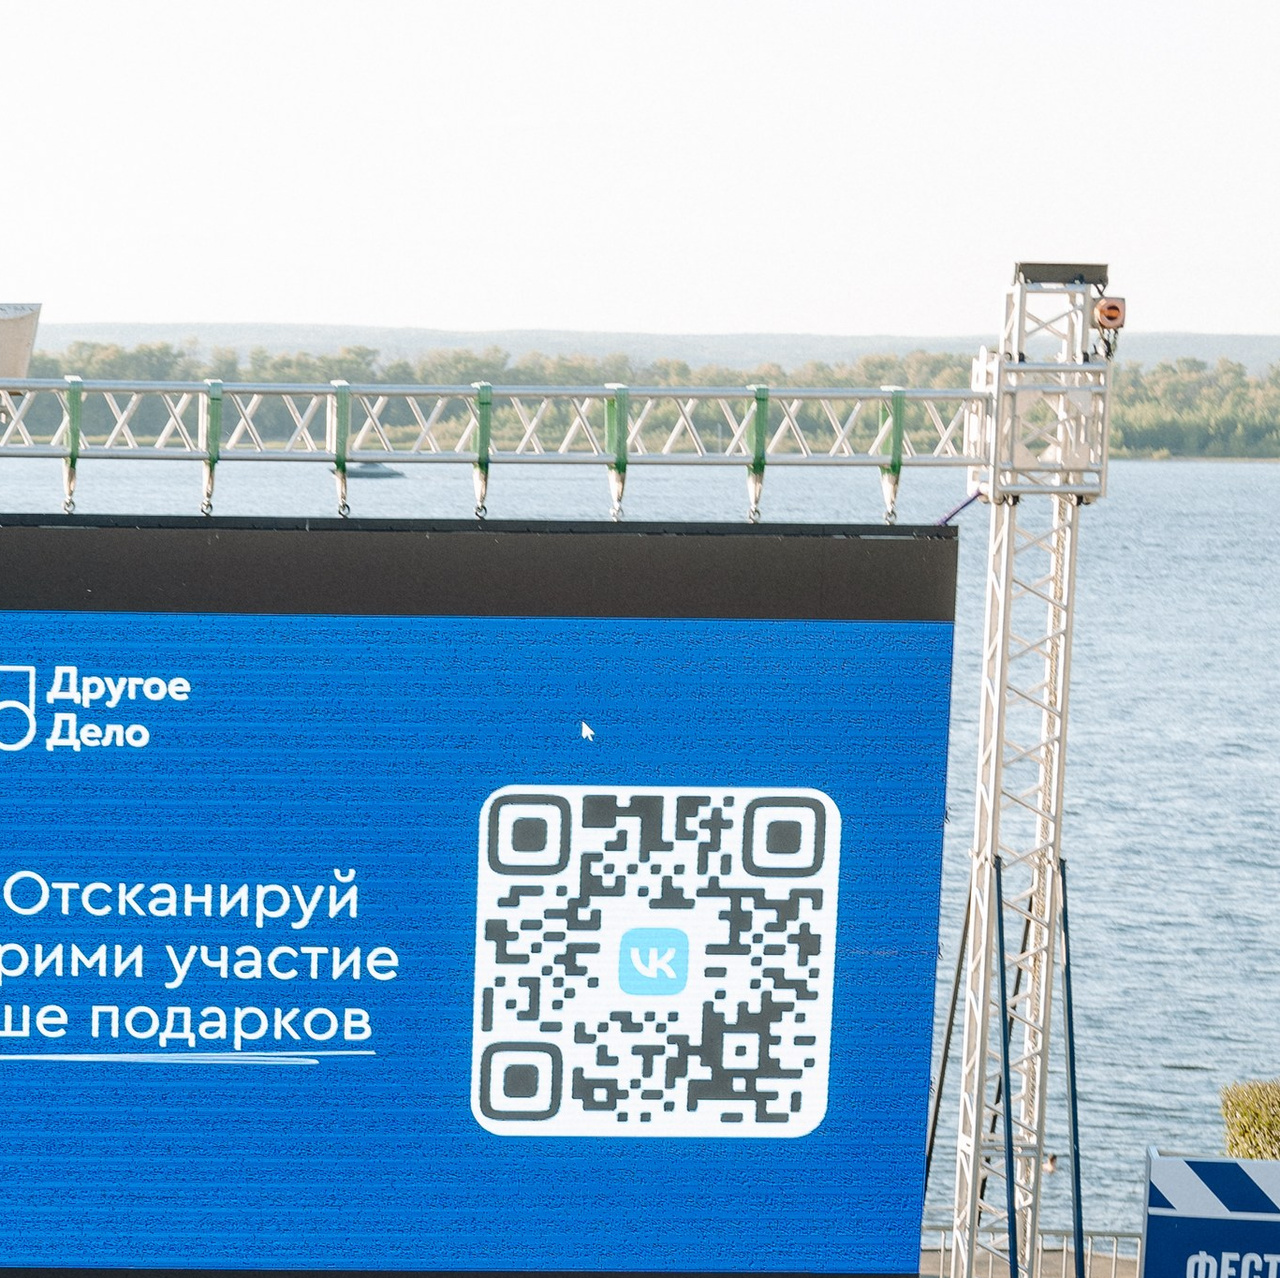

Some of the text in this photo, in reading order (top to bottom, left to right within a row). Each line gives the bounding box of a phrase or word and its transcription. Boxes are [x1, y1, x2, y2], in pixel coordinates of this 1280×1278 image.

[46, 665, 191, 708] Другое
[45, 712, 150, 752] Дело
[3, 868, 358, 930] Отсканируй
[164, 945, 399, 989] участие
[91, 1003, 375, 1052] подарков
